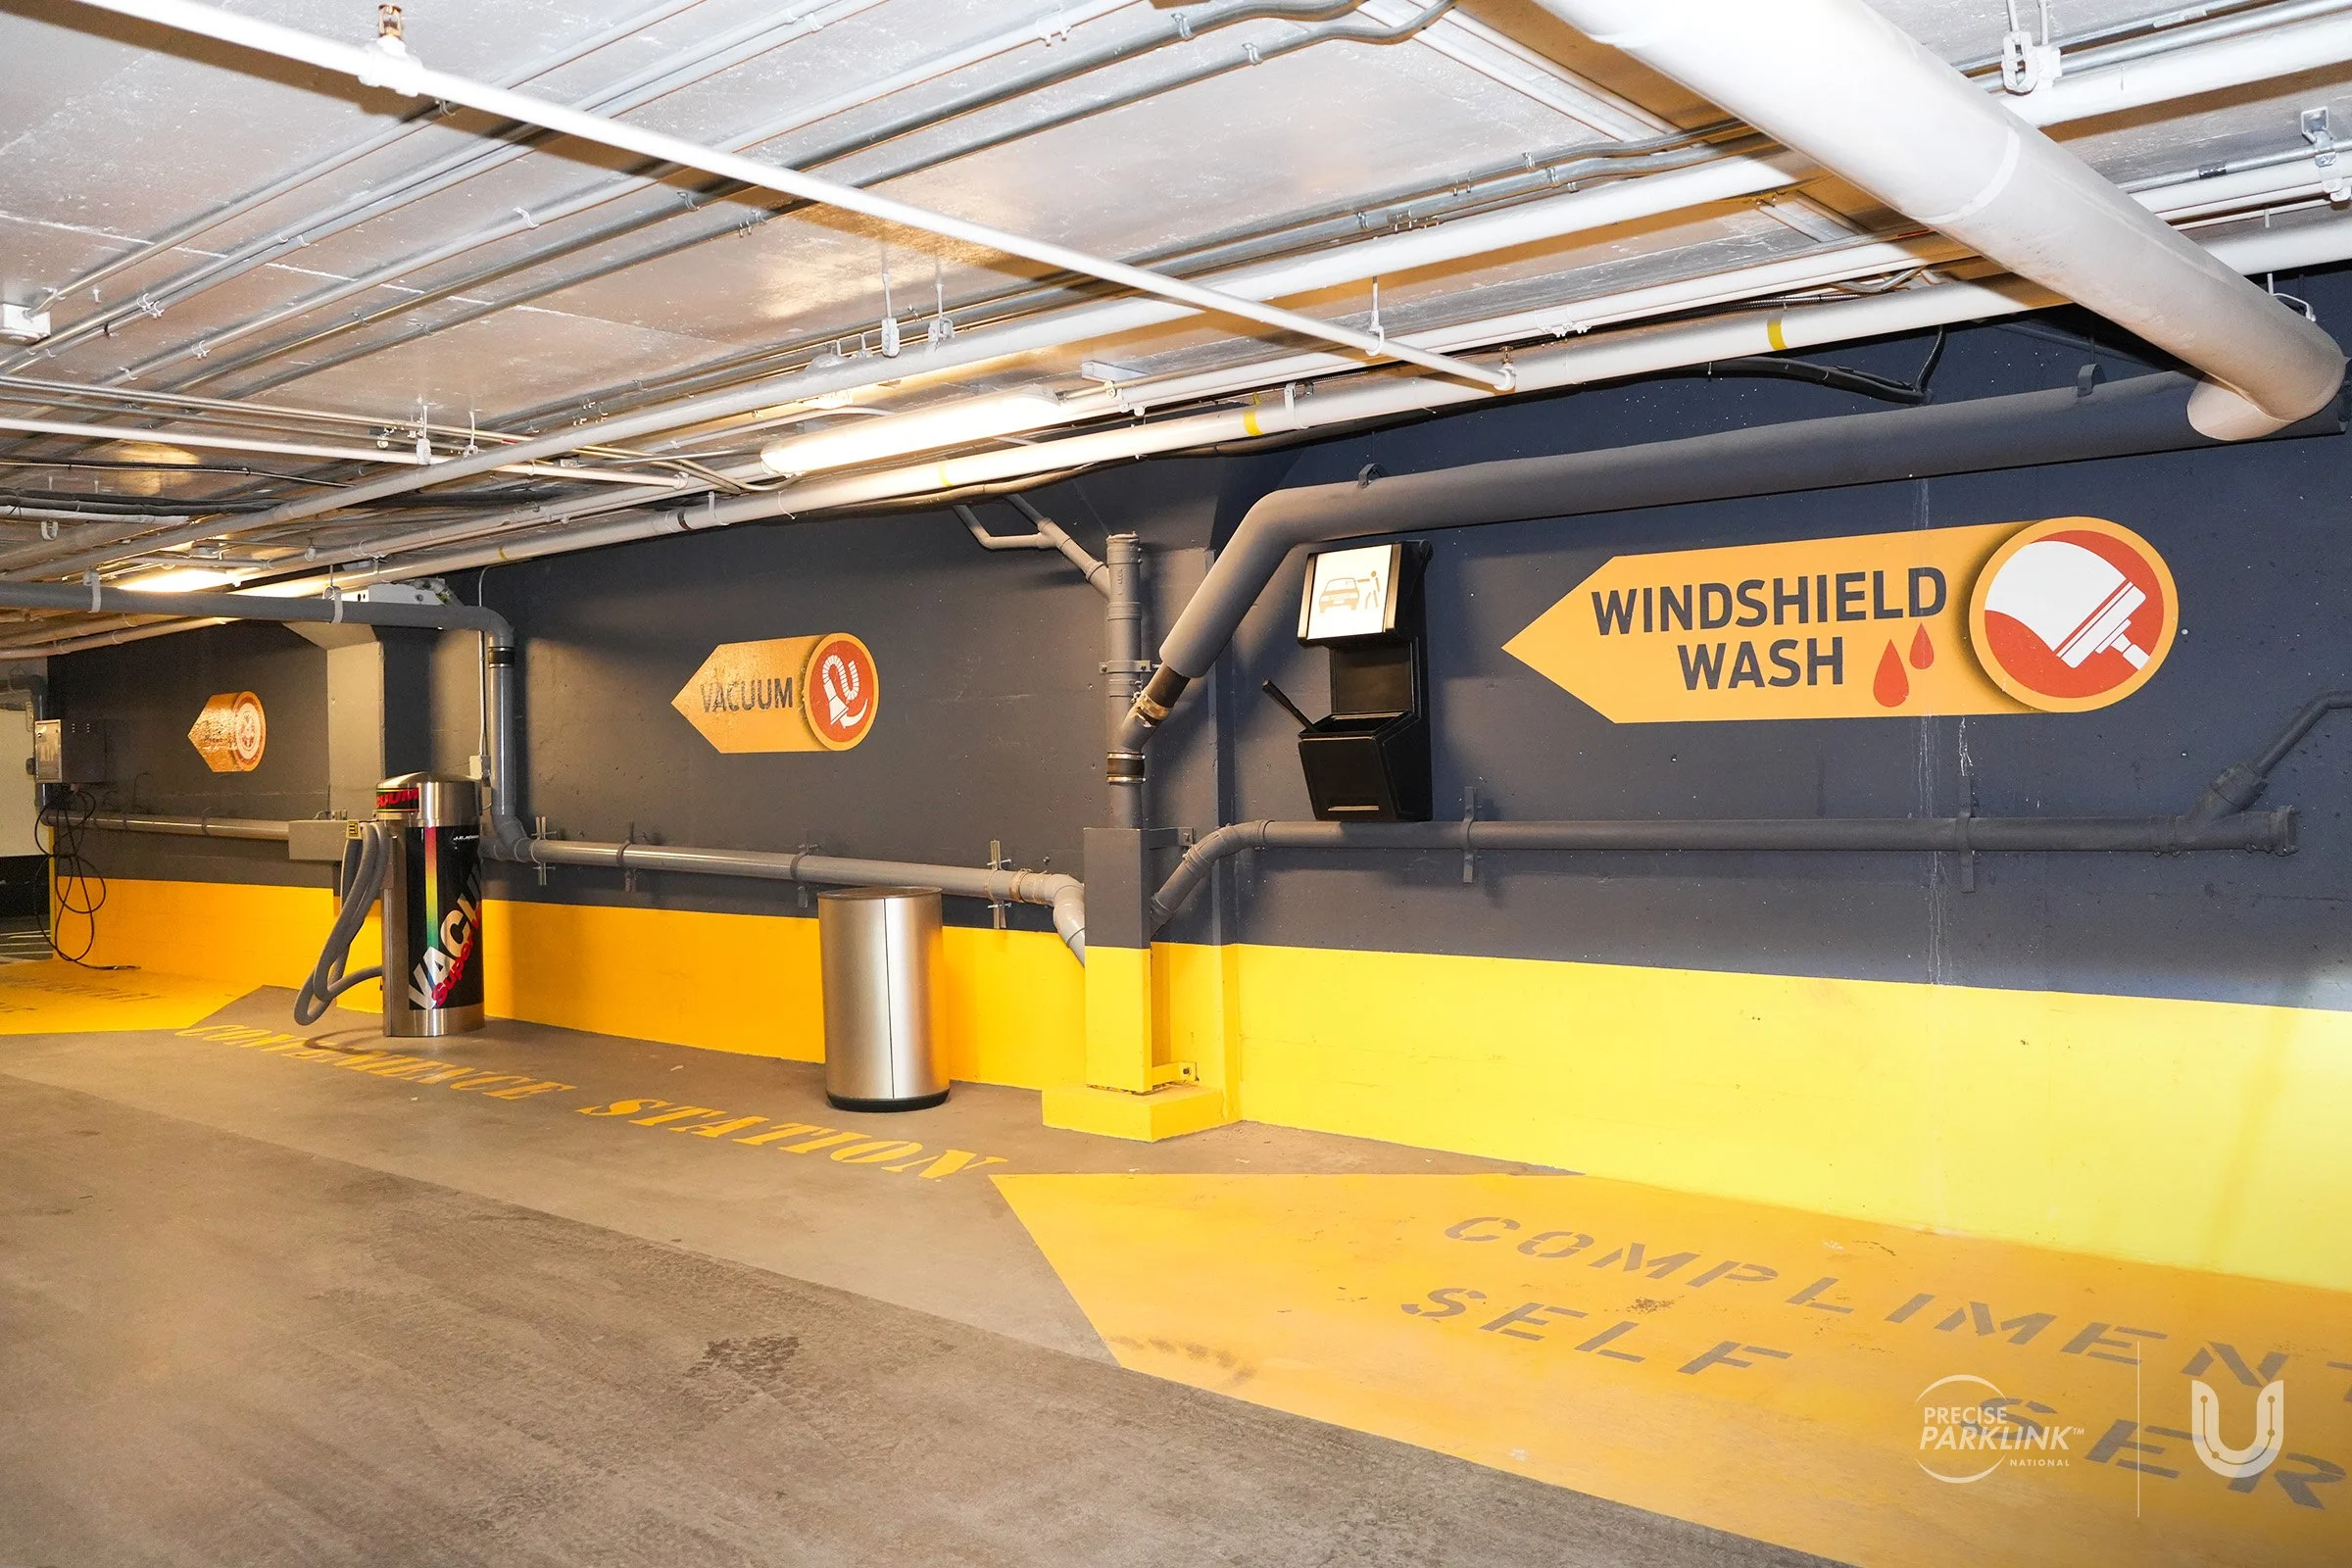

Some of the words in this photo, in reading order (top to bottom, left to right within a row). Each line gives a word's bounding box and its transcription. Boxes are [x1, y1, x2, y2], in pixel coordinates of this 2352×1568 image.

[1592, 566, 1947, 635] WINDSHIELD
[701, 677, 793, 713] VACUUM
[1677, 637, 1843, 691] WASH
[576, 1099, 1008, 1179] STATION
[1401, 1287, 1793, 1375] SELF
